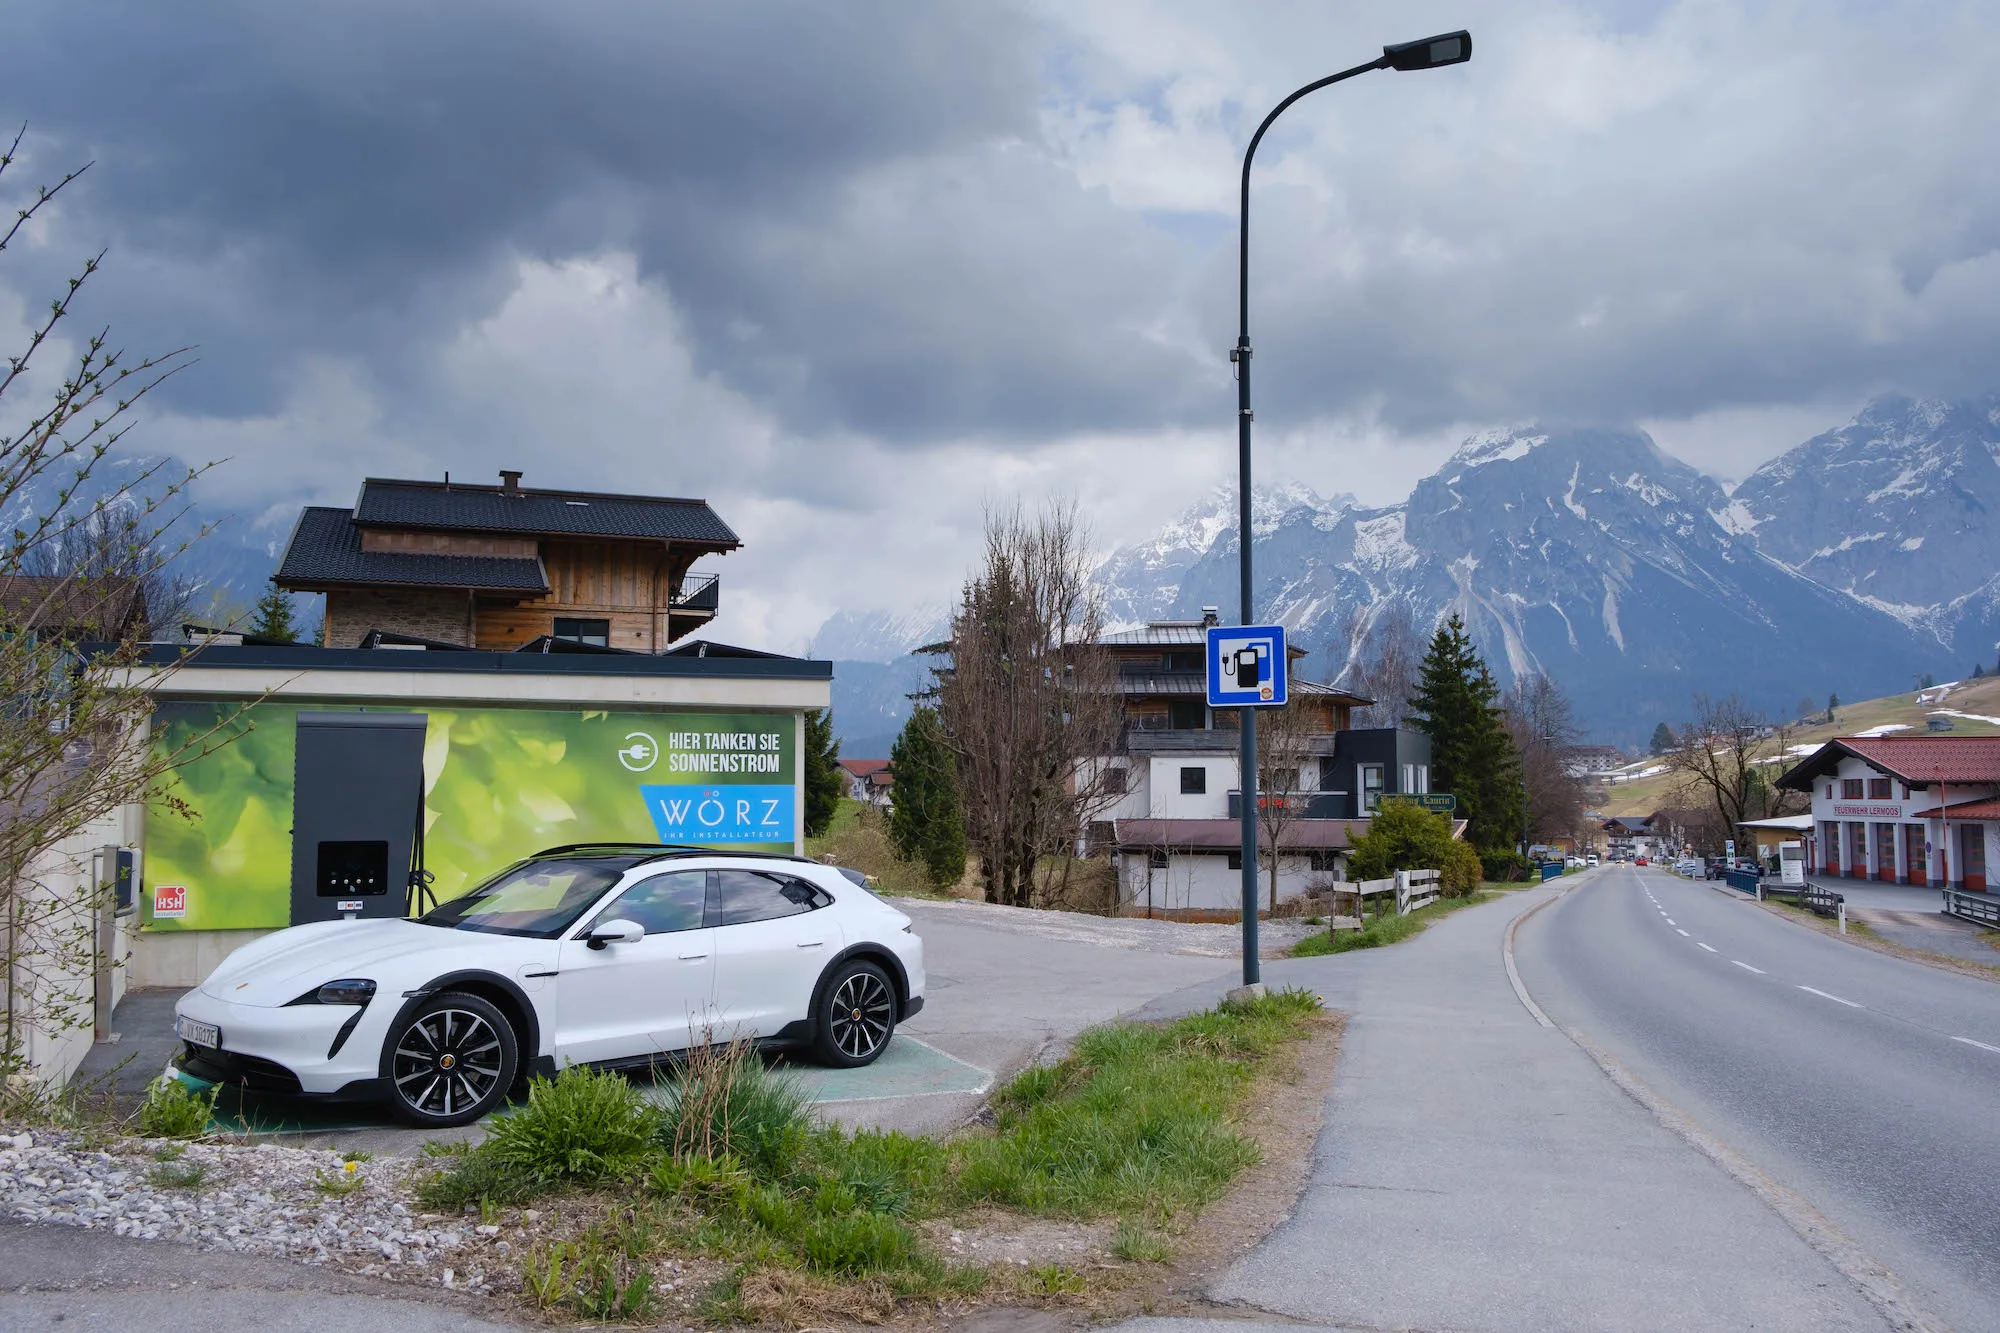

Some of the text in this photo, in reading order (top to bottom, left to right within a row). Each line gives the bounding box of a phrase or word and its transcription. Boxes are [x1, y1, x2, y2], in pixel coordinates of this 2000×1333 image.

[669, 732, 780, 750] HIER TANKEN SIE
[669, 753, 780, 773] SONNENSTROM
[660, 790, 780, 826] WÖRZ
[1423, 795, 1450, 805] Laurin
[1834, 806, 1899, 816] FEUERWEHR LERMOOS
[158, 893, 183, 909] HSH
